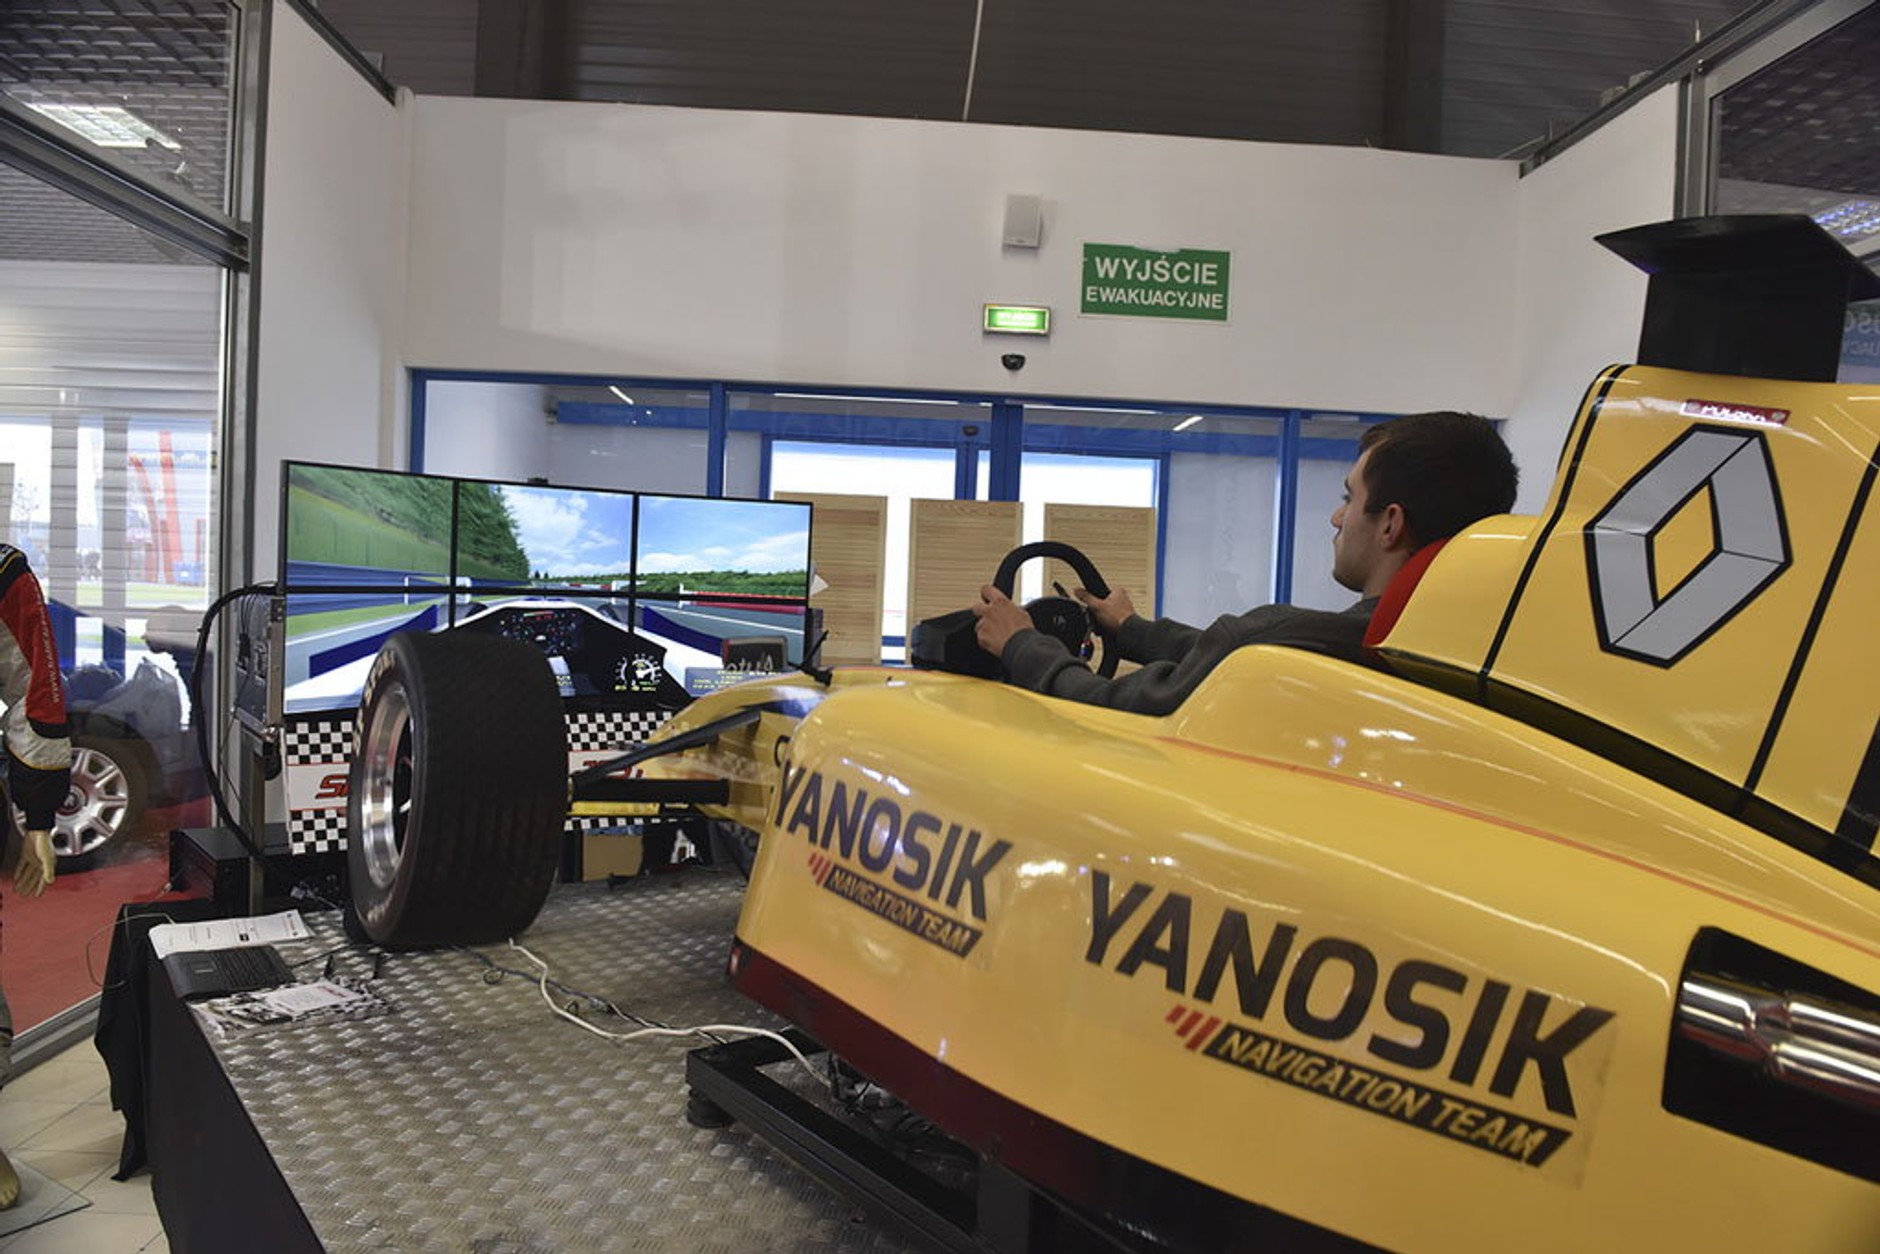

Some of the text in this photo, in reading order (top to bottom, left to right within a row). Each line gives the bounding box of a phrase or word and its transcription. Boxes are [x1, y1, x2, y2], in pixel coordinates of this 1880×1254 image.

[1086, 286, 1224, 310] EWAKUACYJNE
[1094, 255, 1218, 285] WYJŚCIE
[774, 760, 1014, 922] YANOSIK
[829, 868, 974, 952] NAVIGATION TEAM
[1084, 869, 1617, 1119] YANOSIK
[1217, 1028, 1548, 1162] NAVIGATION TEAM
